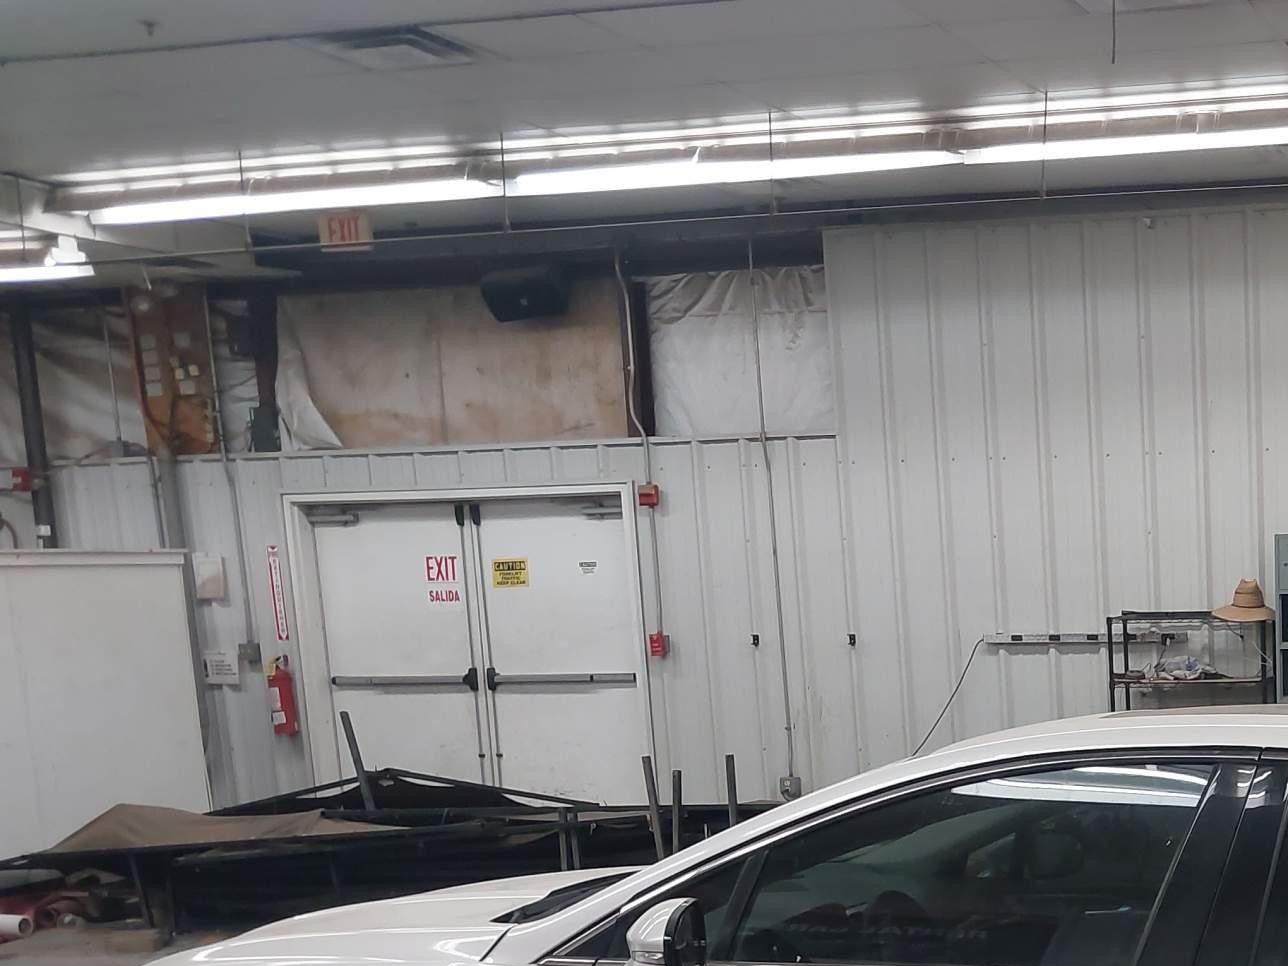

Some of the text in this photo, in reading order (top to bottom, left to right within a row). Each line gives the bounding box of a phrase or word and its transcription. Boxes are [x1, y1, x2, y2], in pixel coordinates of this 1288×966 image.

[328, 216, 359, 242] EXIT
[426, 556, 457, 581] EXIT
[495, 562, 526, 570] CAUTION
[429, 590, 460, 602] SALIDA
